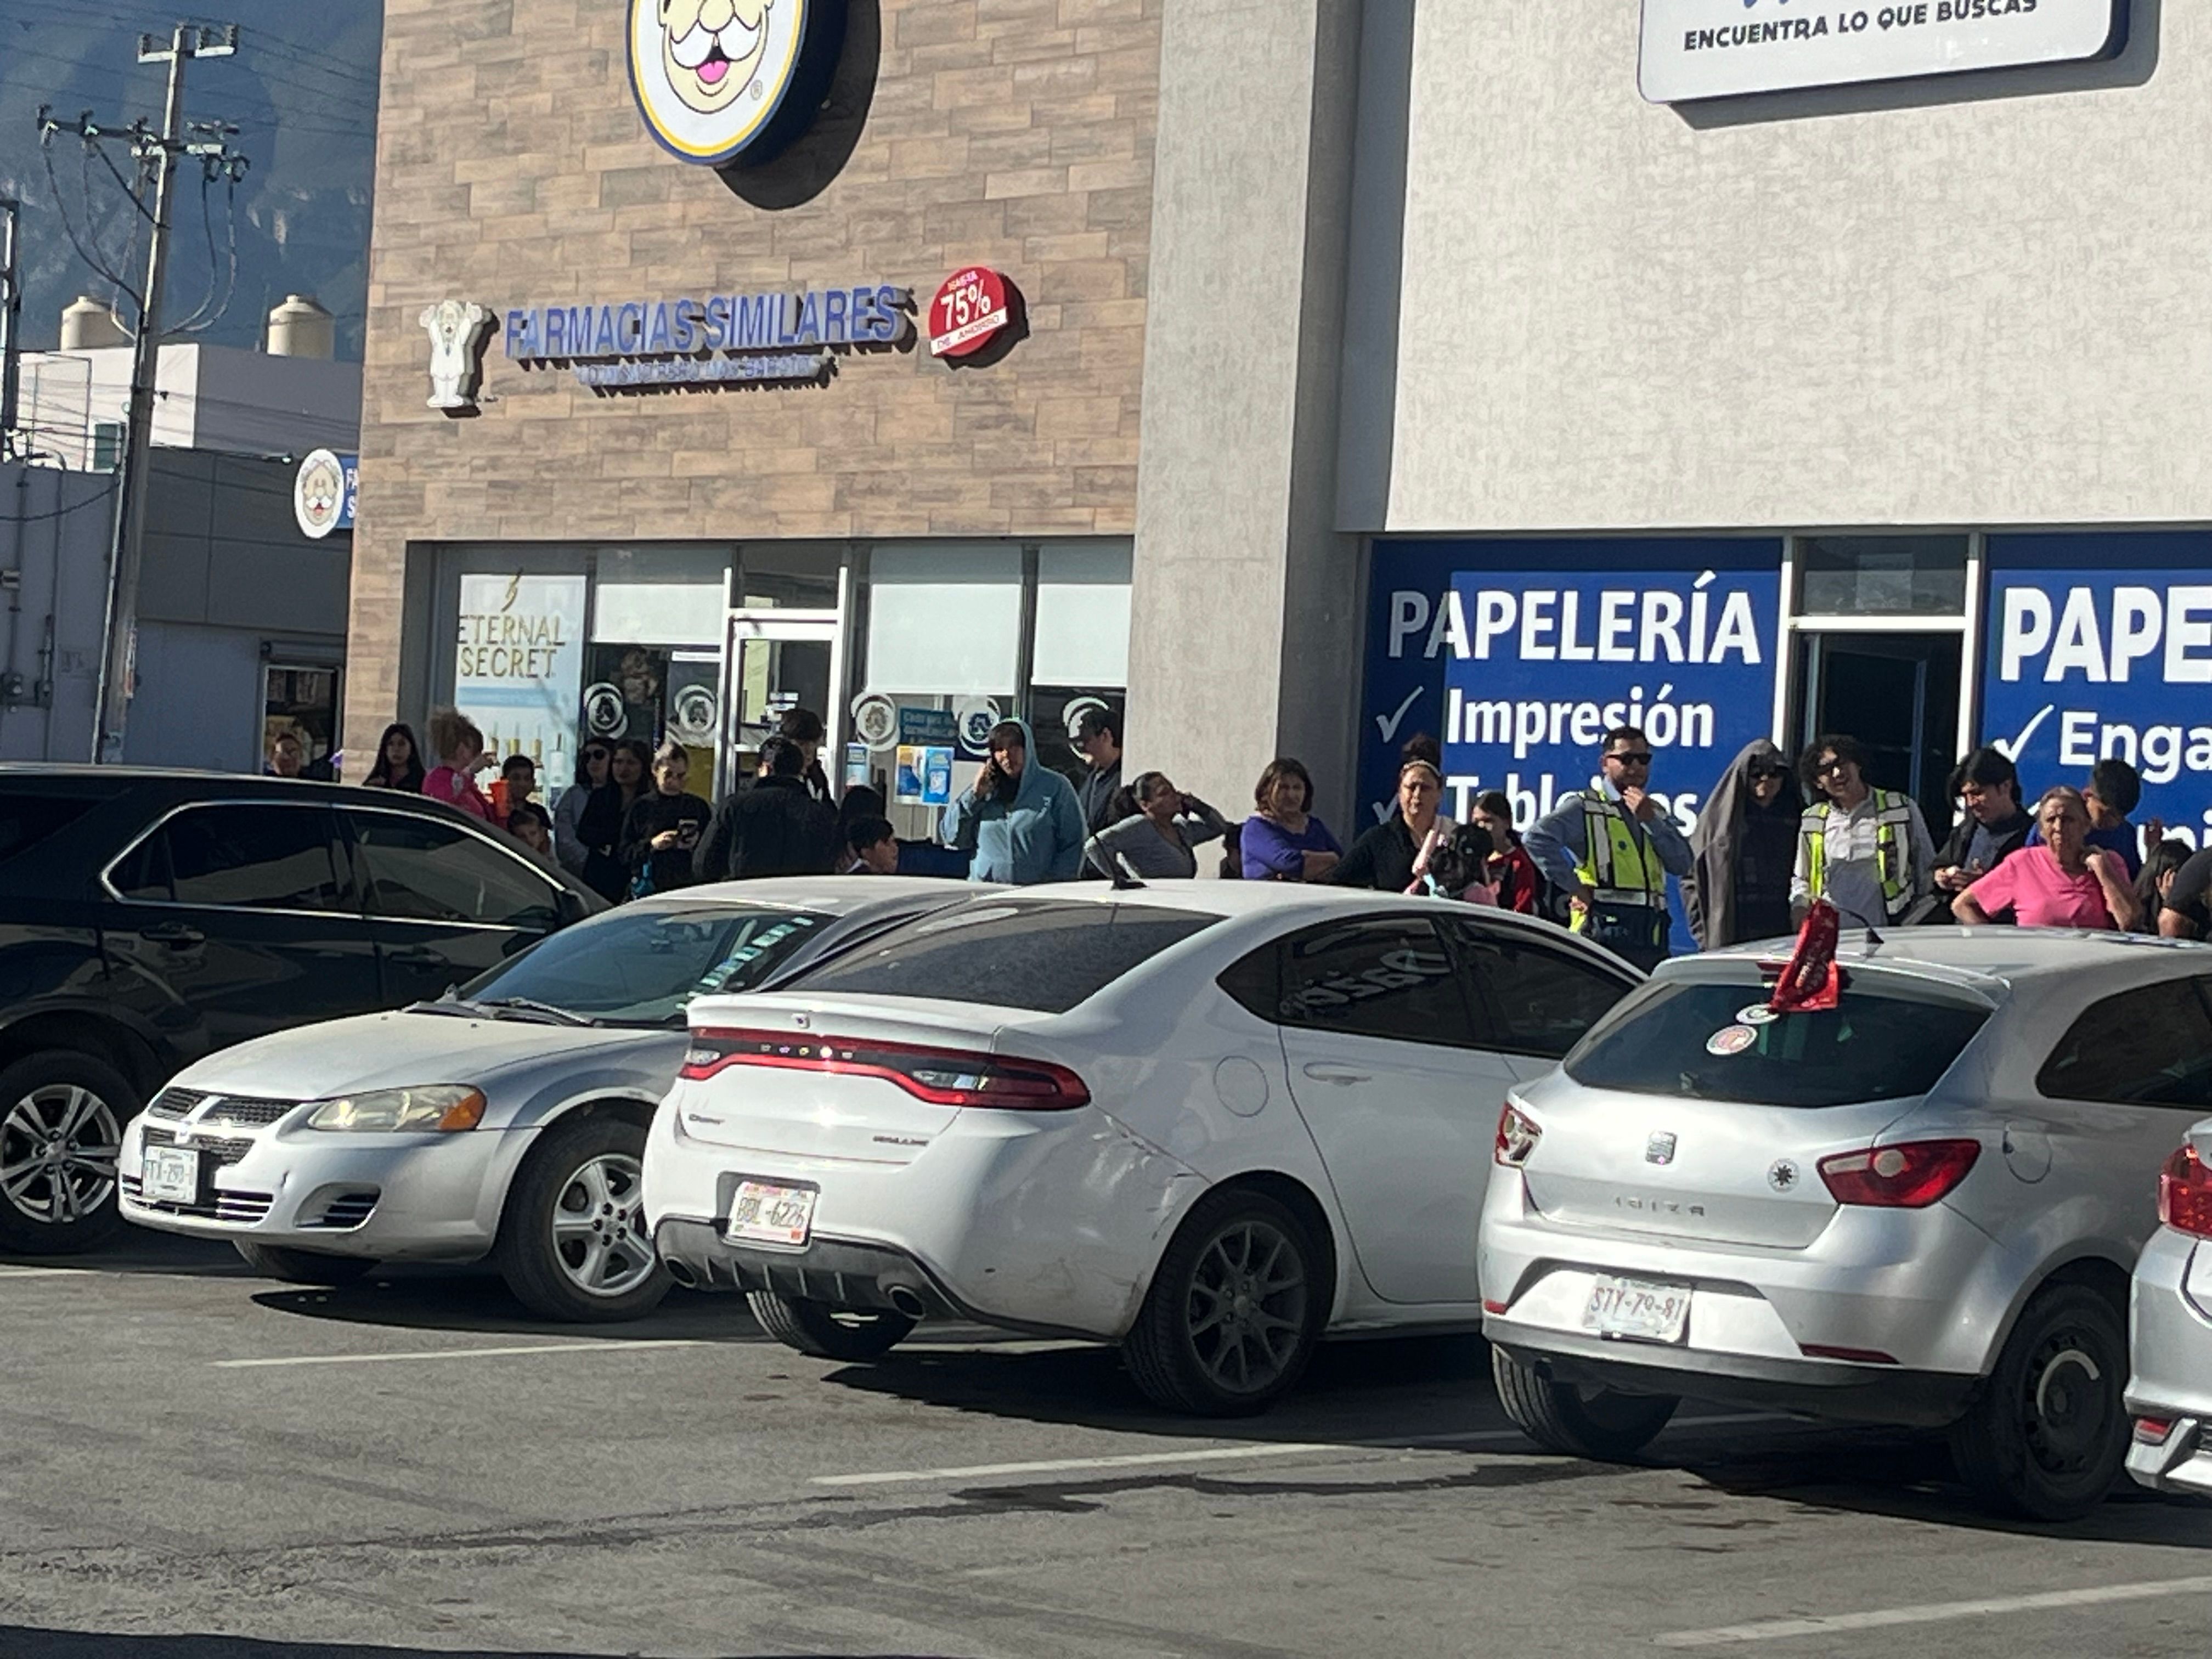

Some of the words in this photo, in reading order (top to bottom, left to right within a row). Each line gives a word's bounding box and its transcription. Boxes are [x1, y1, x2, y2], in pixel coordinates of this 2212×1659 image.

[1684, 16, 1829, 51] ENCUENTRA
[1838, 11, 1869, 33] LO
[1877, 4, 1927, 30] QUE
[1937, 0, 2036, 21] BUSCAS
[505, 299, 695, 357] FARMACIAS
[705, 285, 897, 350] SIMILARES
[940, 279, 991, 330] 75%
[458, 614, 566, 646] ETERNAL
[1387, 569, 1763, 665] PAPELERÍA
[2000, 585, 2212, 684] PAPE
[460, 646, 557, 679] SECRET
[1447, 683, 1714, 759] Impresión
[2059, 711, 2212, 785] Enga
